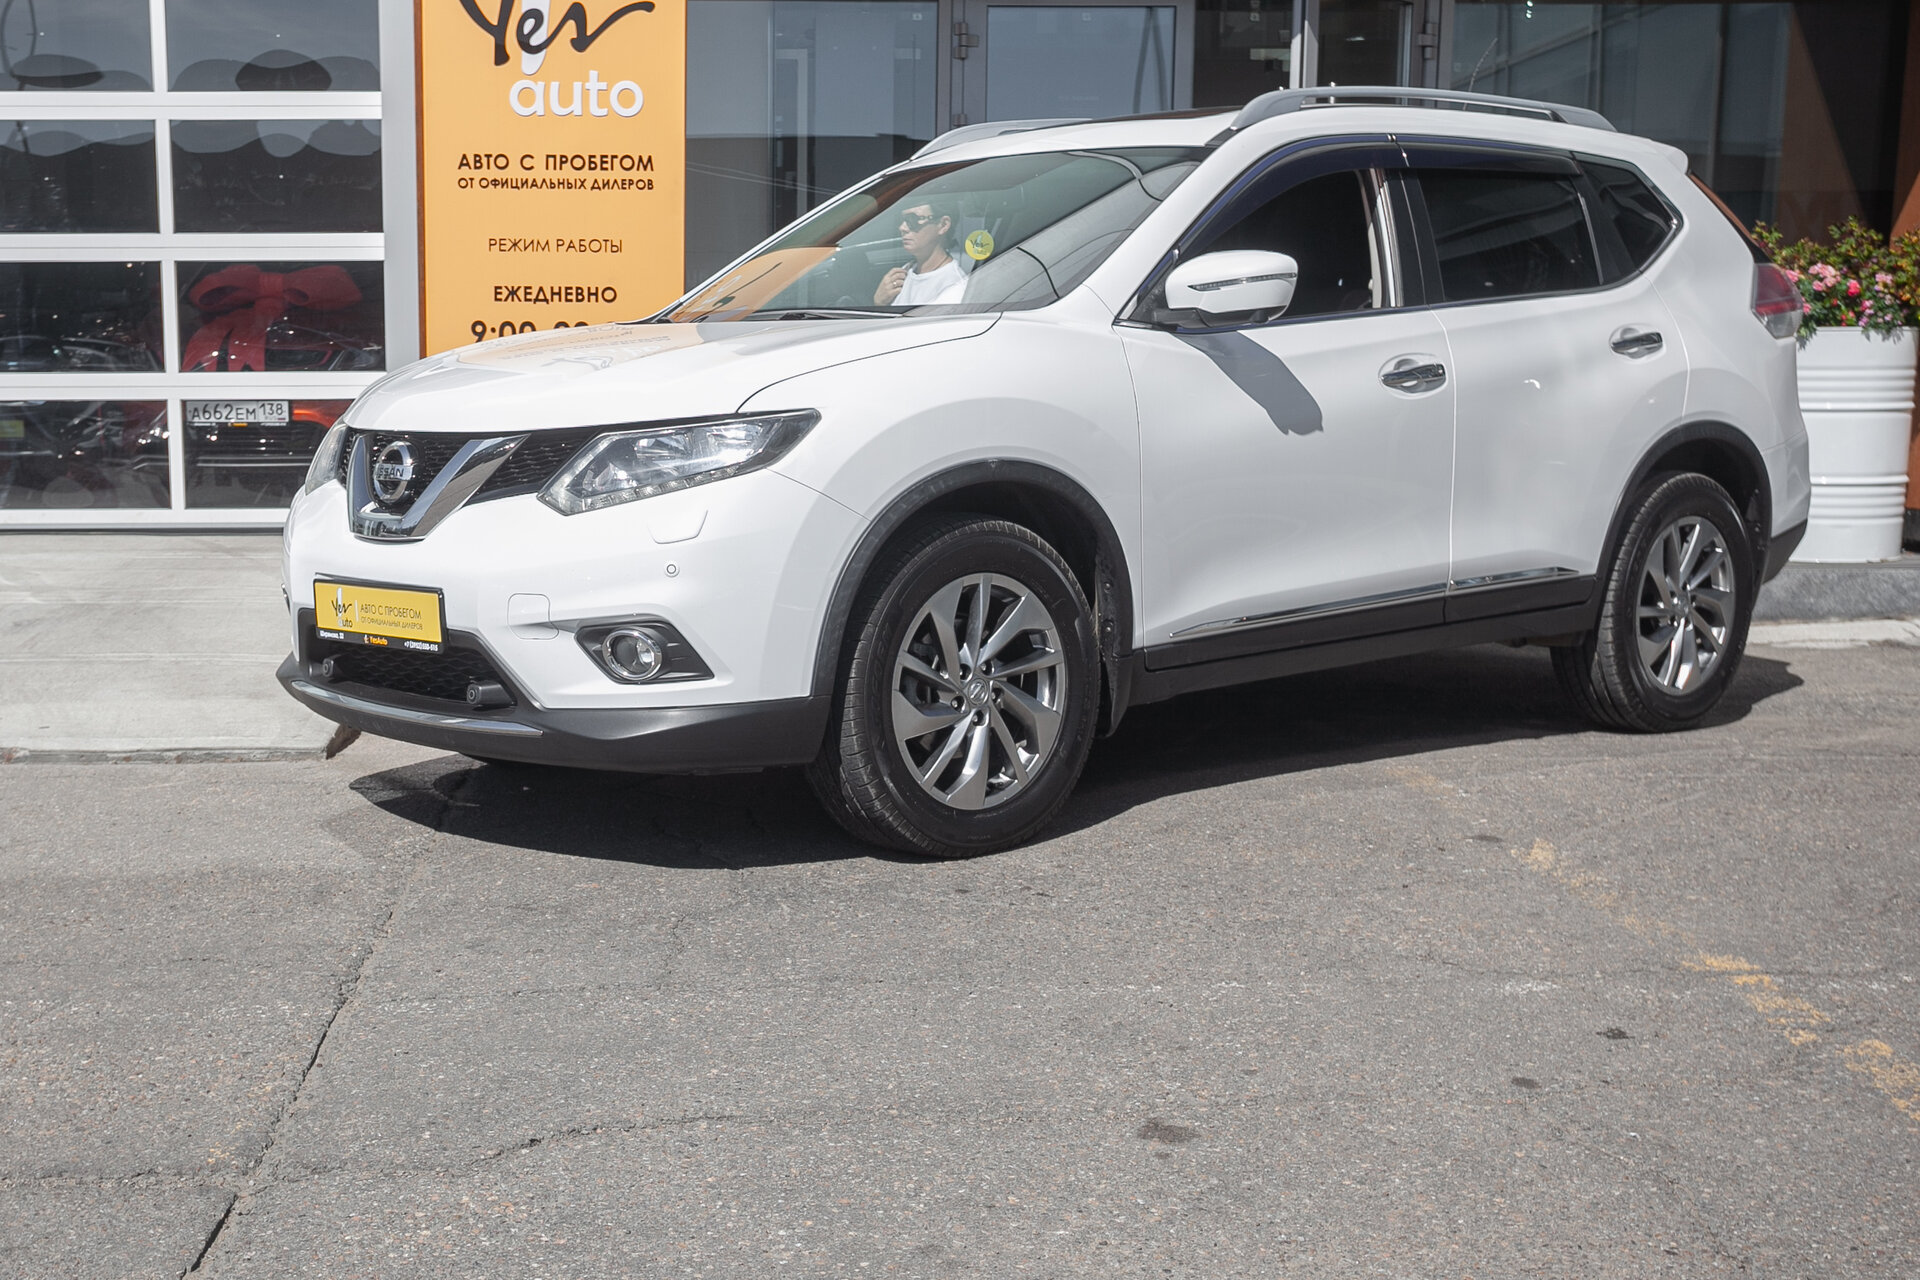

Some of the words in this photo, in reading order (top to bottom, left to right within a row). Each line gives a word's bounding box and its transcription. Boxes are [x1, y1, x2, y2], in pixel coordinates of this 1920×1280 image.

[459, 0, 655, 66] Yes
[509, 70, 644, 117] auto
[458, 154, 510, 170] АВТО
[520, 154, 535, 171] С
[545, 154, 654, 171] ПРОБЕГОМ
[457, 177, 475, 189] ОТ
[478, 177, 587, 190] ОФИЦИАЛЬНЫХ
[590, 178, 654, 191] ДИЛЕРОВ
[488, 238, 550, 252] РЕЖИМ
[556, 238, 623, 253] РАБОТЫ
[493, 285, 618, 304] ЕЖЕДНЕВНО
[259, 402, 284, 416] 138
[360, 604, 376, 615] АВТО
[385, 605, 421, 619] ПРОБЕГОМ
